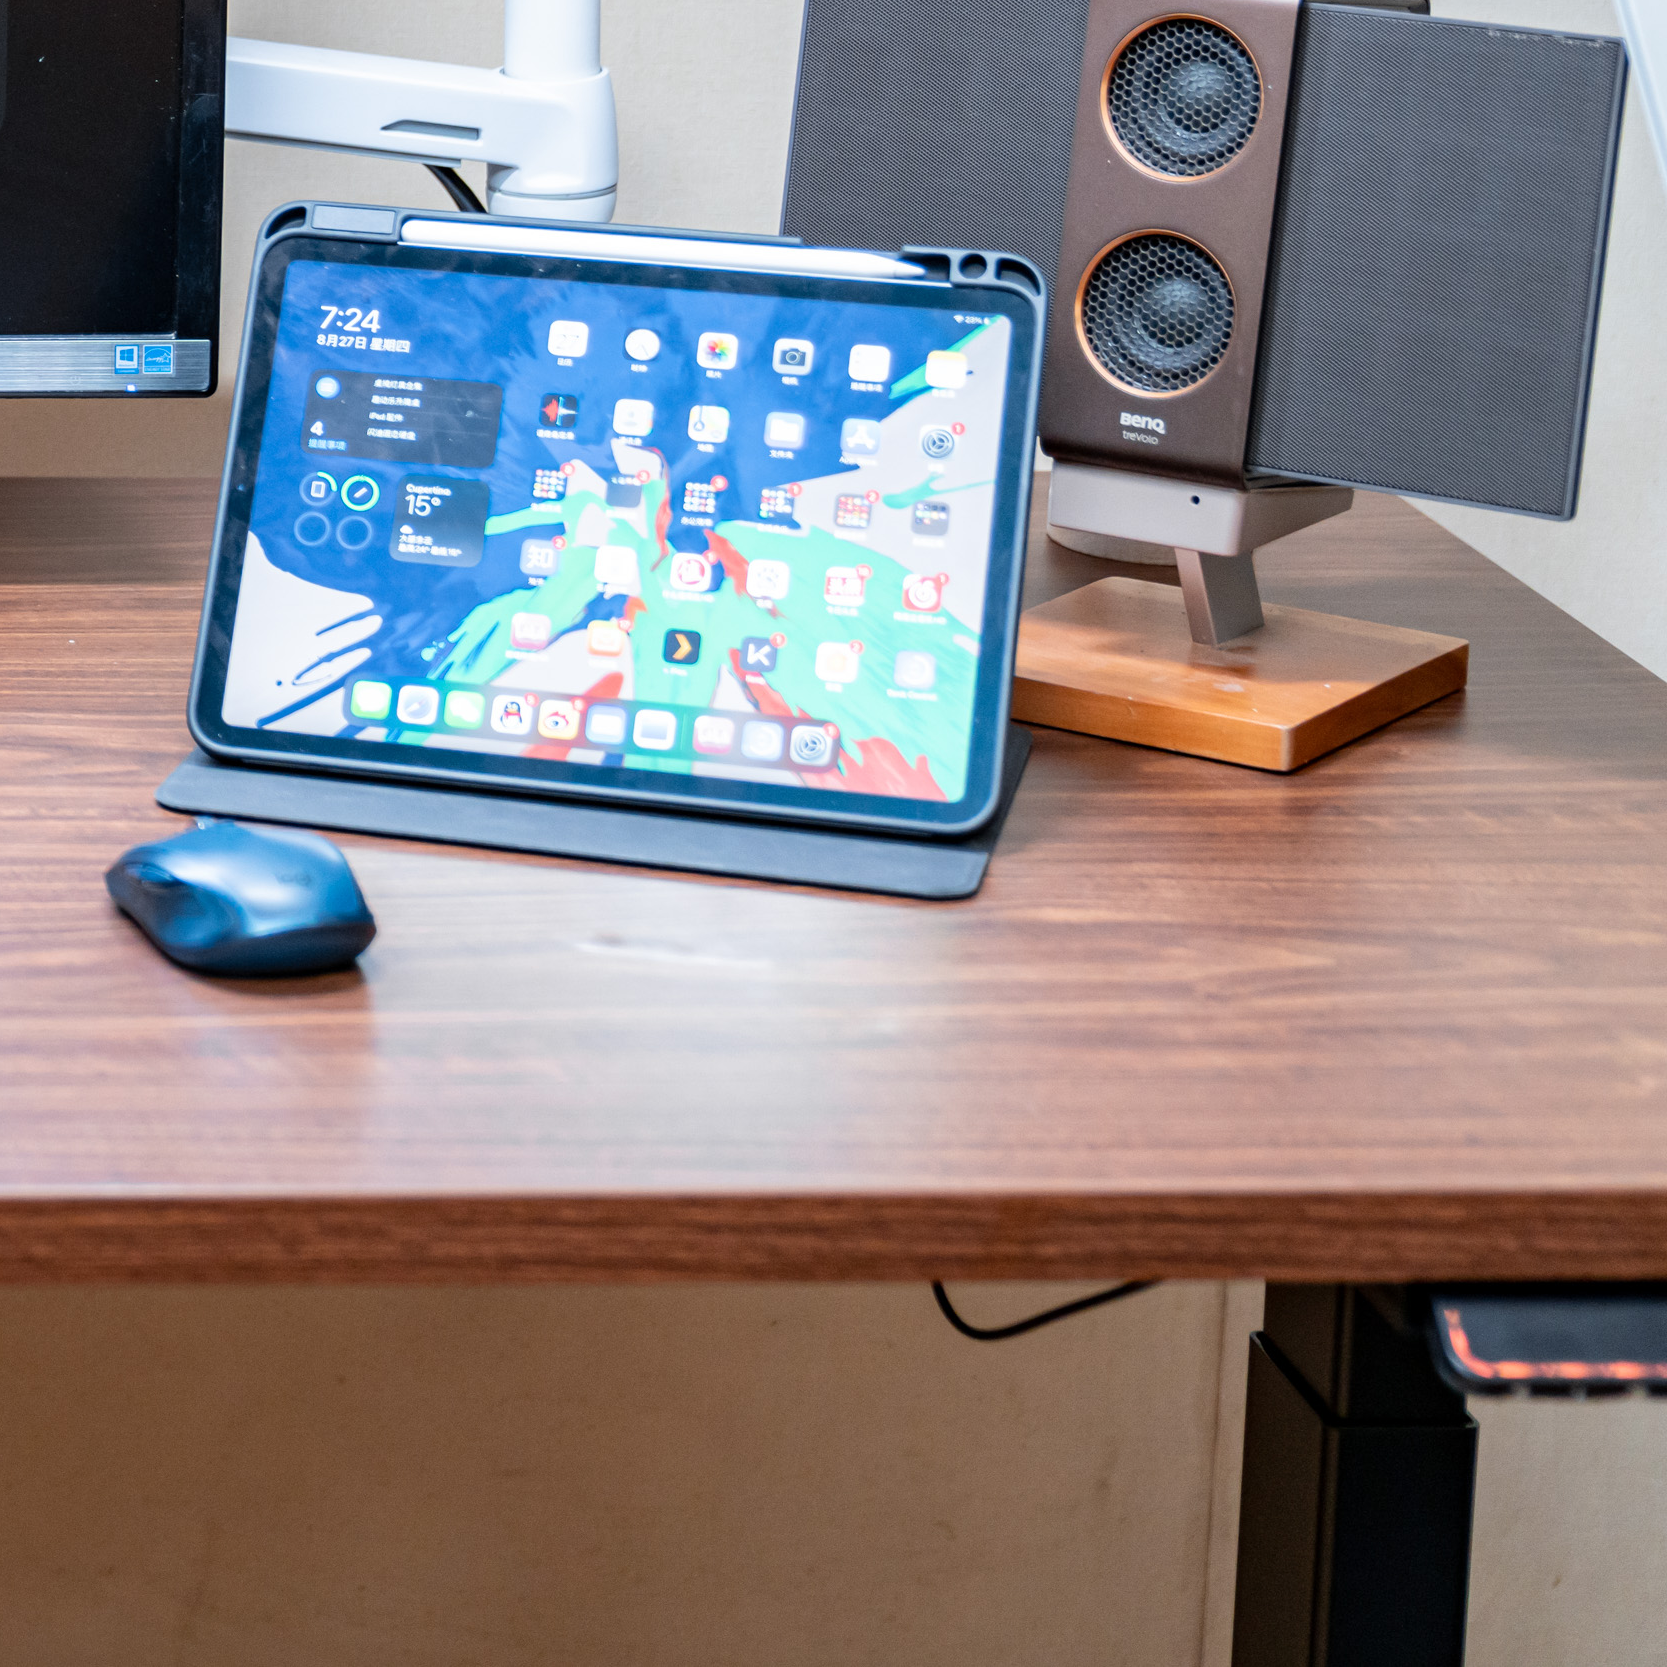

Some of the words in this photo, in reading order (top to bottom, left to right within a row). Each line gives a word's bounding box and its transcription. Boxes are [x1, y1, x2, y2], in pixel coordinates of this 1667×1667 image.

[320, 305, 381, 333] 7:24
[317, 334, 367, 350] 8月27日
[310, 421, 324, 436] 4
[1120, 412, 1166, 434] BenQ
[526, 545, 554, 569] 知
